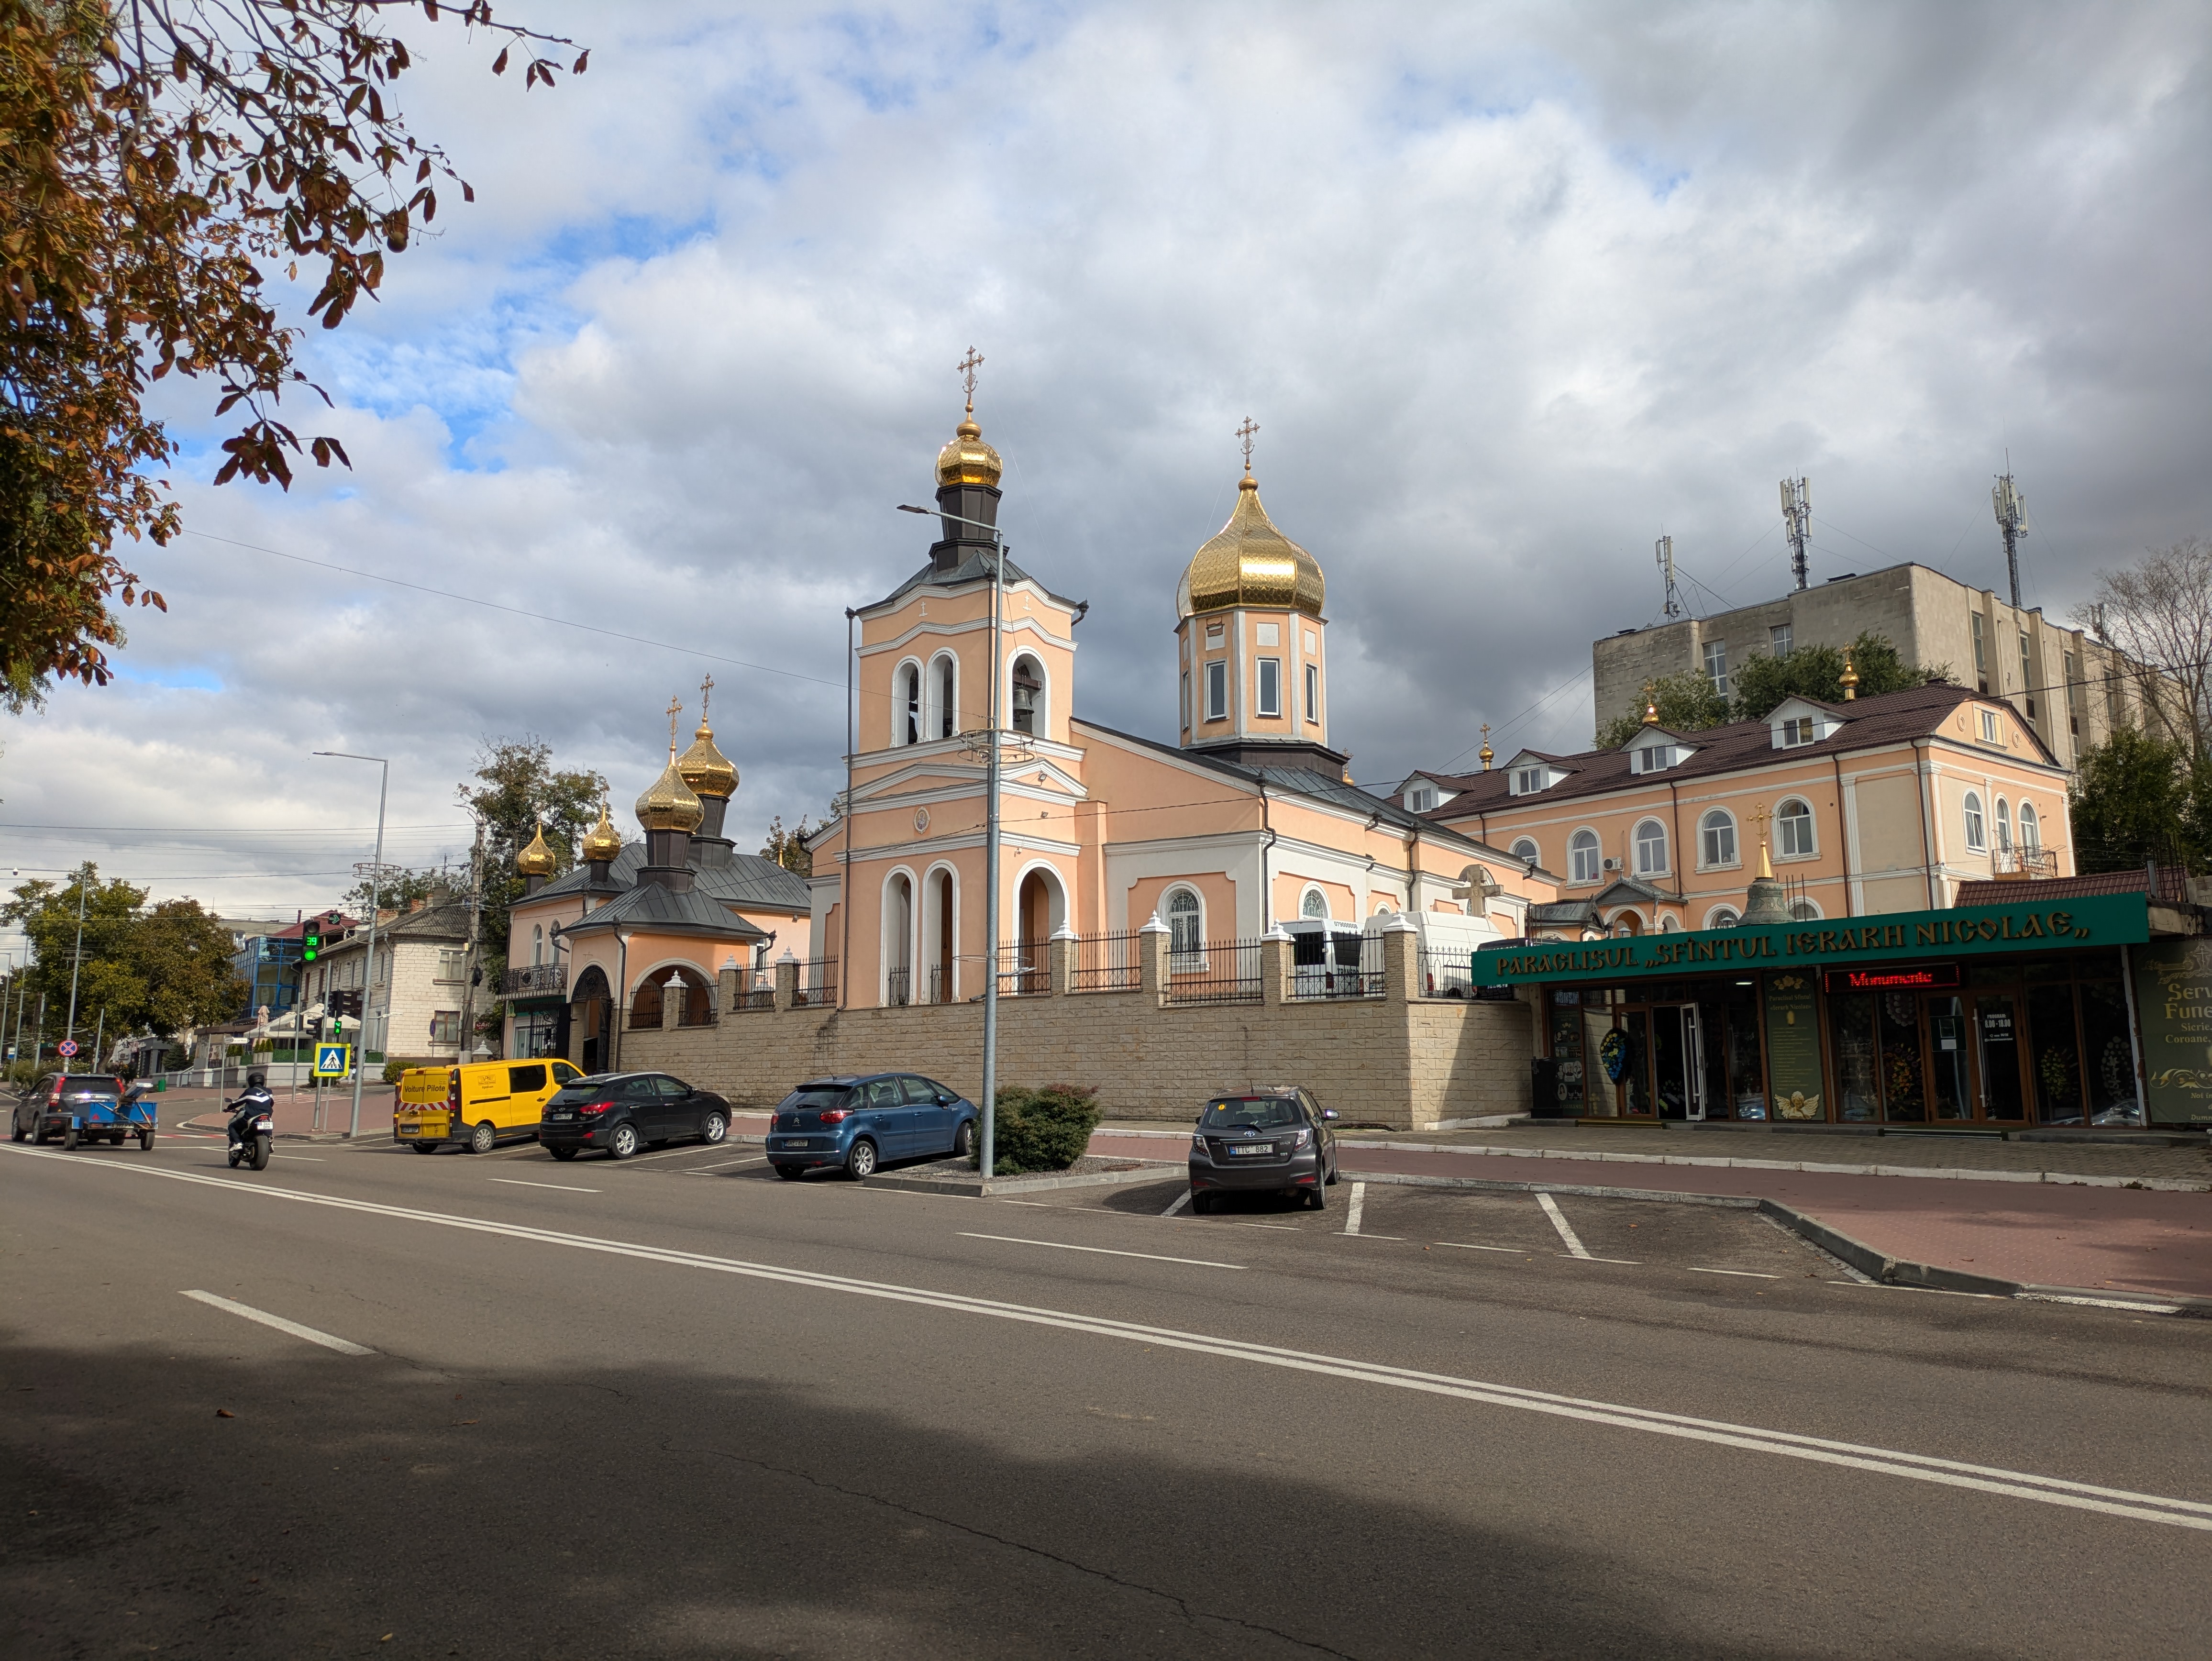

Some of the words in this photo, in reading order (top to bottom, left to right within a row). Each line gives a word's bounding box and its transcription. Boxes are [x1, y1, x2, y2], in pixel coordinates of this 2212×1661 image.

[307, 937, 317, 945] 39
[1496, 947, 1639, 975] PARACLISUL
[1786, 924, 1905, 955] IERARH
[2166, 1034, 2211, 1043] Coroane,
